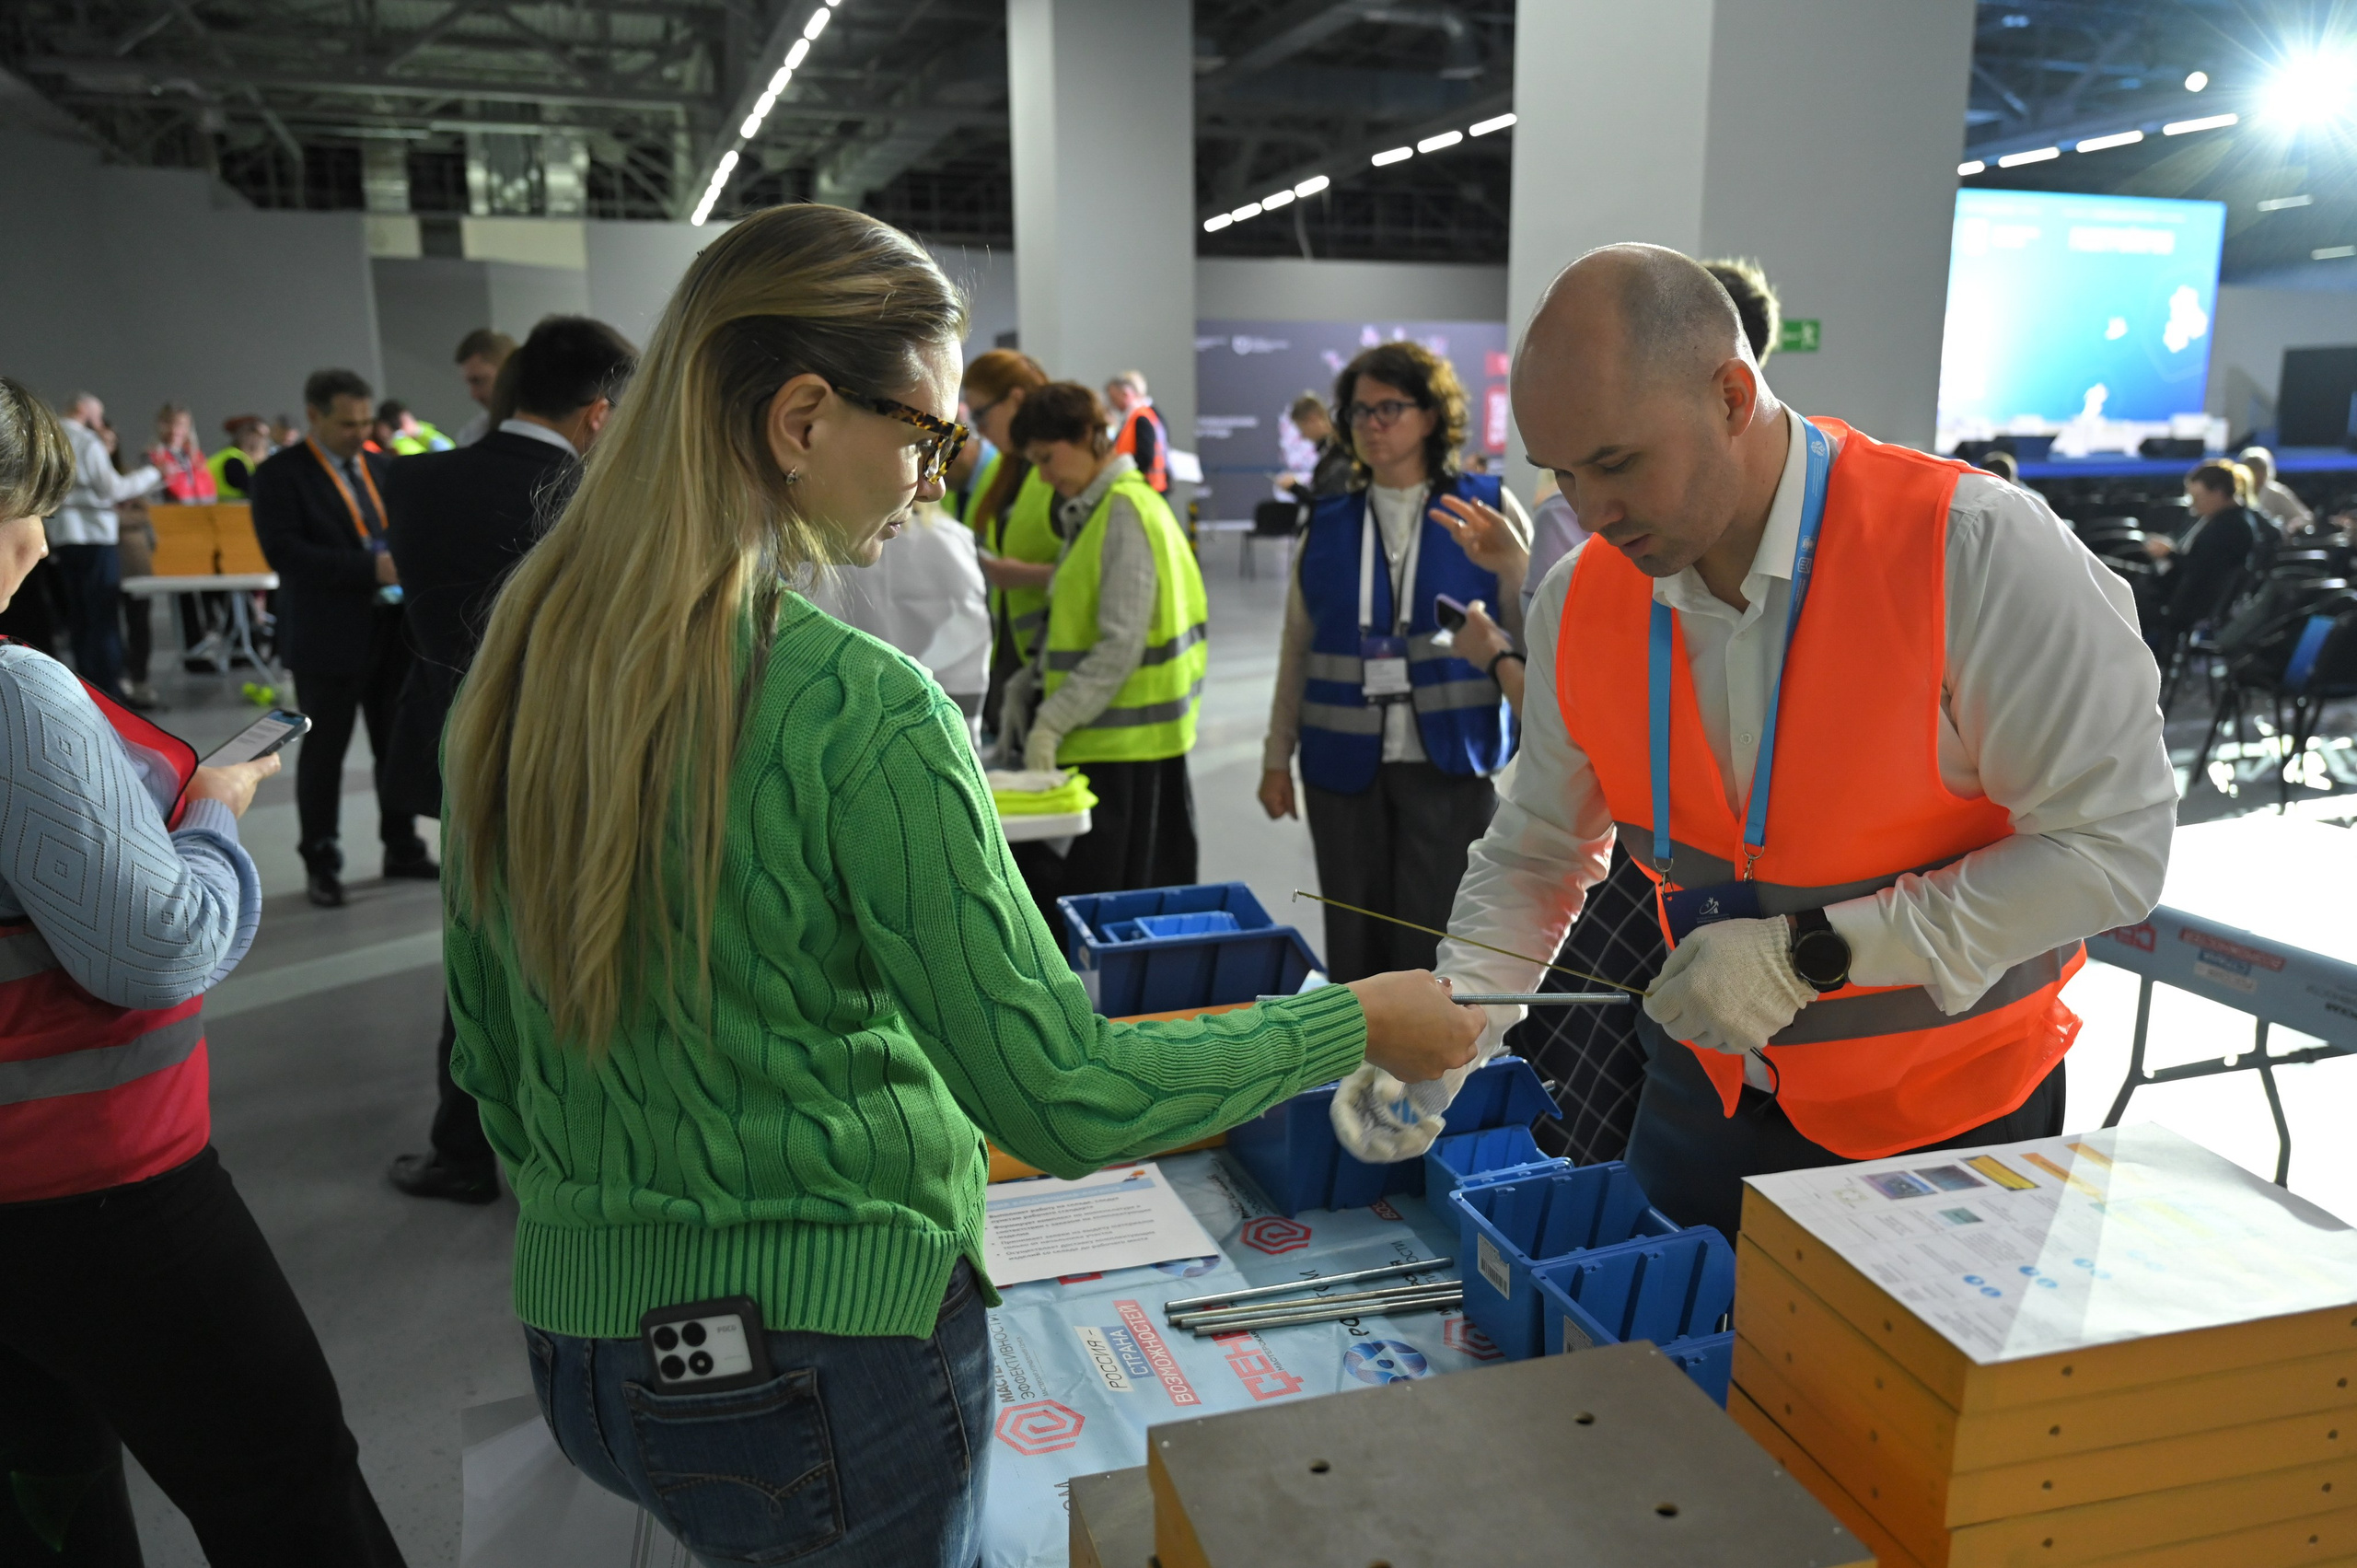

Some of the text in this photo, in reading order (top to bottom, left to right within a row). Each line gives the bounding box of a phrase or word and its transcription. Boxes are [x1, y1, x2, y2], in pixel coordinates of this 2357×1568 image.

[988, 1314, 1035, 1400] ЭФФЕКТИВНОСТИ
[1086, 1340, 1128, 1388] РОССИЯ
[1109, 1329, 1149, 1376] СТРАНА
[1117, 1304, 1195, 1403] ВОЗМОЖНОСТЕЙ
